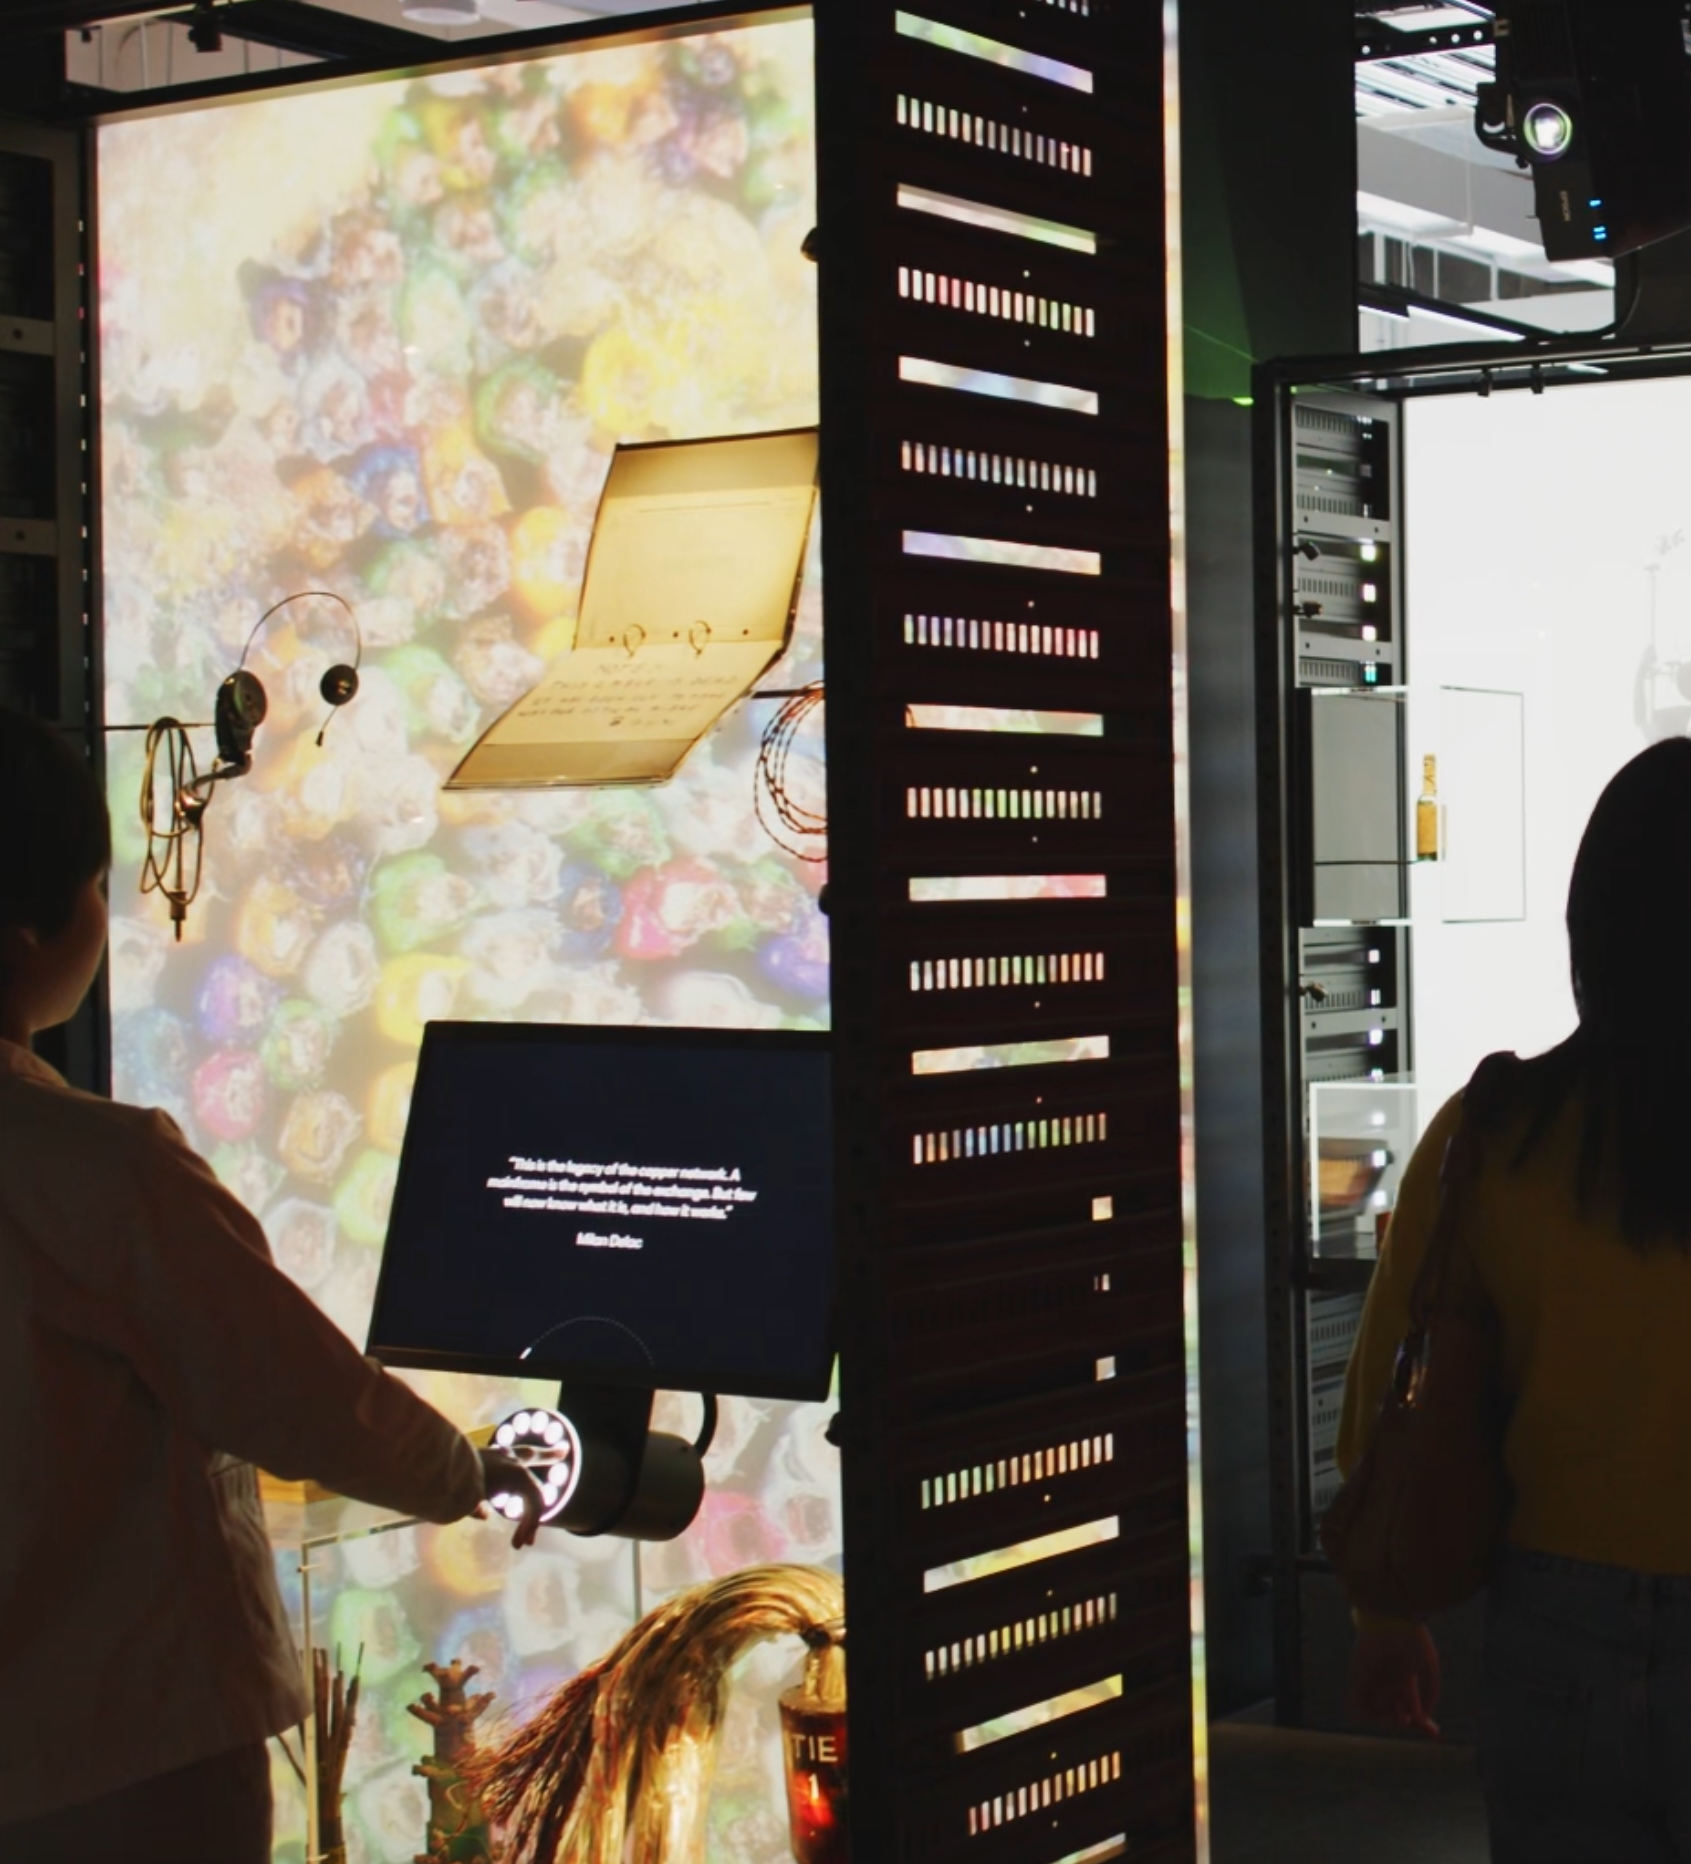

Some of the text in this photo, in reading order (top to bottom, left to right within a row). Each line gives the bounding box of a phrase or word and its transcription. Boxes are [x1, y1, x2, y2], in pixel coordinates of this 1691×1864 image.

[547, 1158, 566, 1173] the
[566, 1160, 604, 1178] legacy
[604, 1161, 619, 1176] of
[619, 1162, 638, 1177] the
[638, 1166, 680, 1181] copper
[730, 1167, 741, 1182] A
[548, 1178, 557, 1192] is
[558, 1178, 578, 1192] the
[578, 1180, 619, 1196] symbol
[619, 1181, 633, 1195] of
[632, 1182, 652, 1197] the
[712, 1185, 733, 1200] But
[733, 1186, 758, 1202] few
[503, 1194, 523, 1208] will
[578, 1198, 608, 1213] what
[608, 1200, 617, 1213] it
[630, 1201, 654, 1215] and
[654, 1202, 680, 1216] how
[680, 1203, 691, 1217] it
[792, 1731, 838, 1763] TIE
